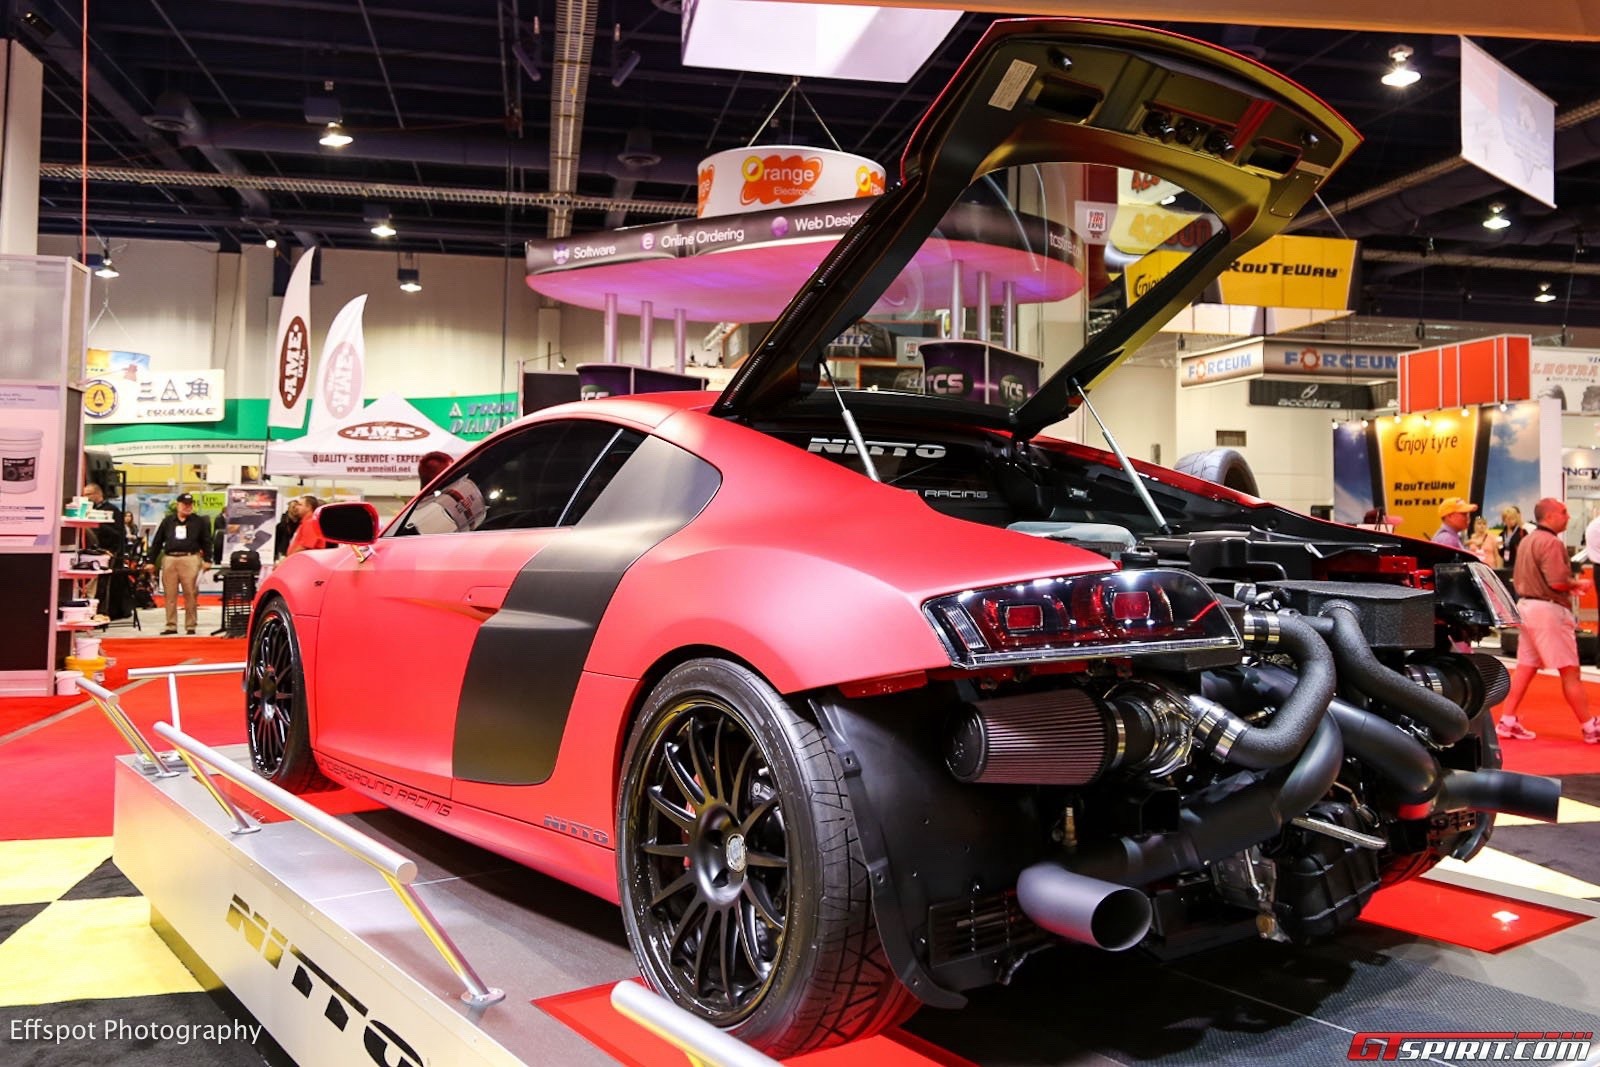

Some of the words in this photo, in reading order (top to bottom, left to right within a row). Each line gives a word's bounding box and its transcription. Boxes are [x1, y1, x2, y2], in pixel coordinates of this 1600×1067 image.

[742, 155, 815, 185] Orange
[795, 217, 824, 232] Web
[825, 212, 863, 228] Desig
[661, 233, 695, 249] Online
[696, 228, 745, 244] Ordering
[573, 245, 617, 260] Software
[284, 331, 303, 397] AME
[1188, 353, 1252, 381] FORCEUM
[1284, 347, 1398, 373] FORCEUM
[926, 373, 964, 395] TCS
[1001, 380, 1024, 402] TCS
[350, 426, 417, 438] AME
[807, 436, 947, 459] NITTO
[1431, 434, 1459, 454] tyre
[312, 454, 348, 464] QUALITY
[354, 454, 390, 464] SERVICE
[924, 489, 989, 499] RACING
[395, 788, 453, 818] RACING
[543, 815, 609, 845] NITTO
[226, 893, 426, 1067] NITTO
